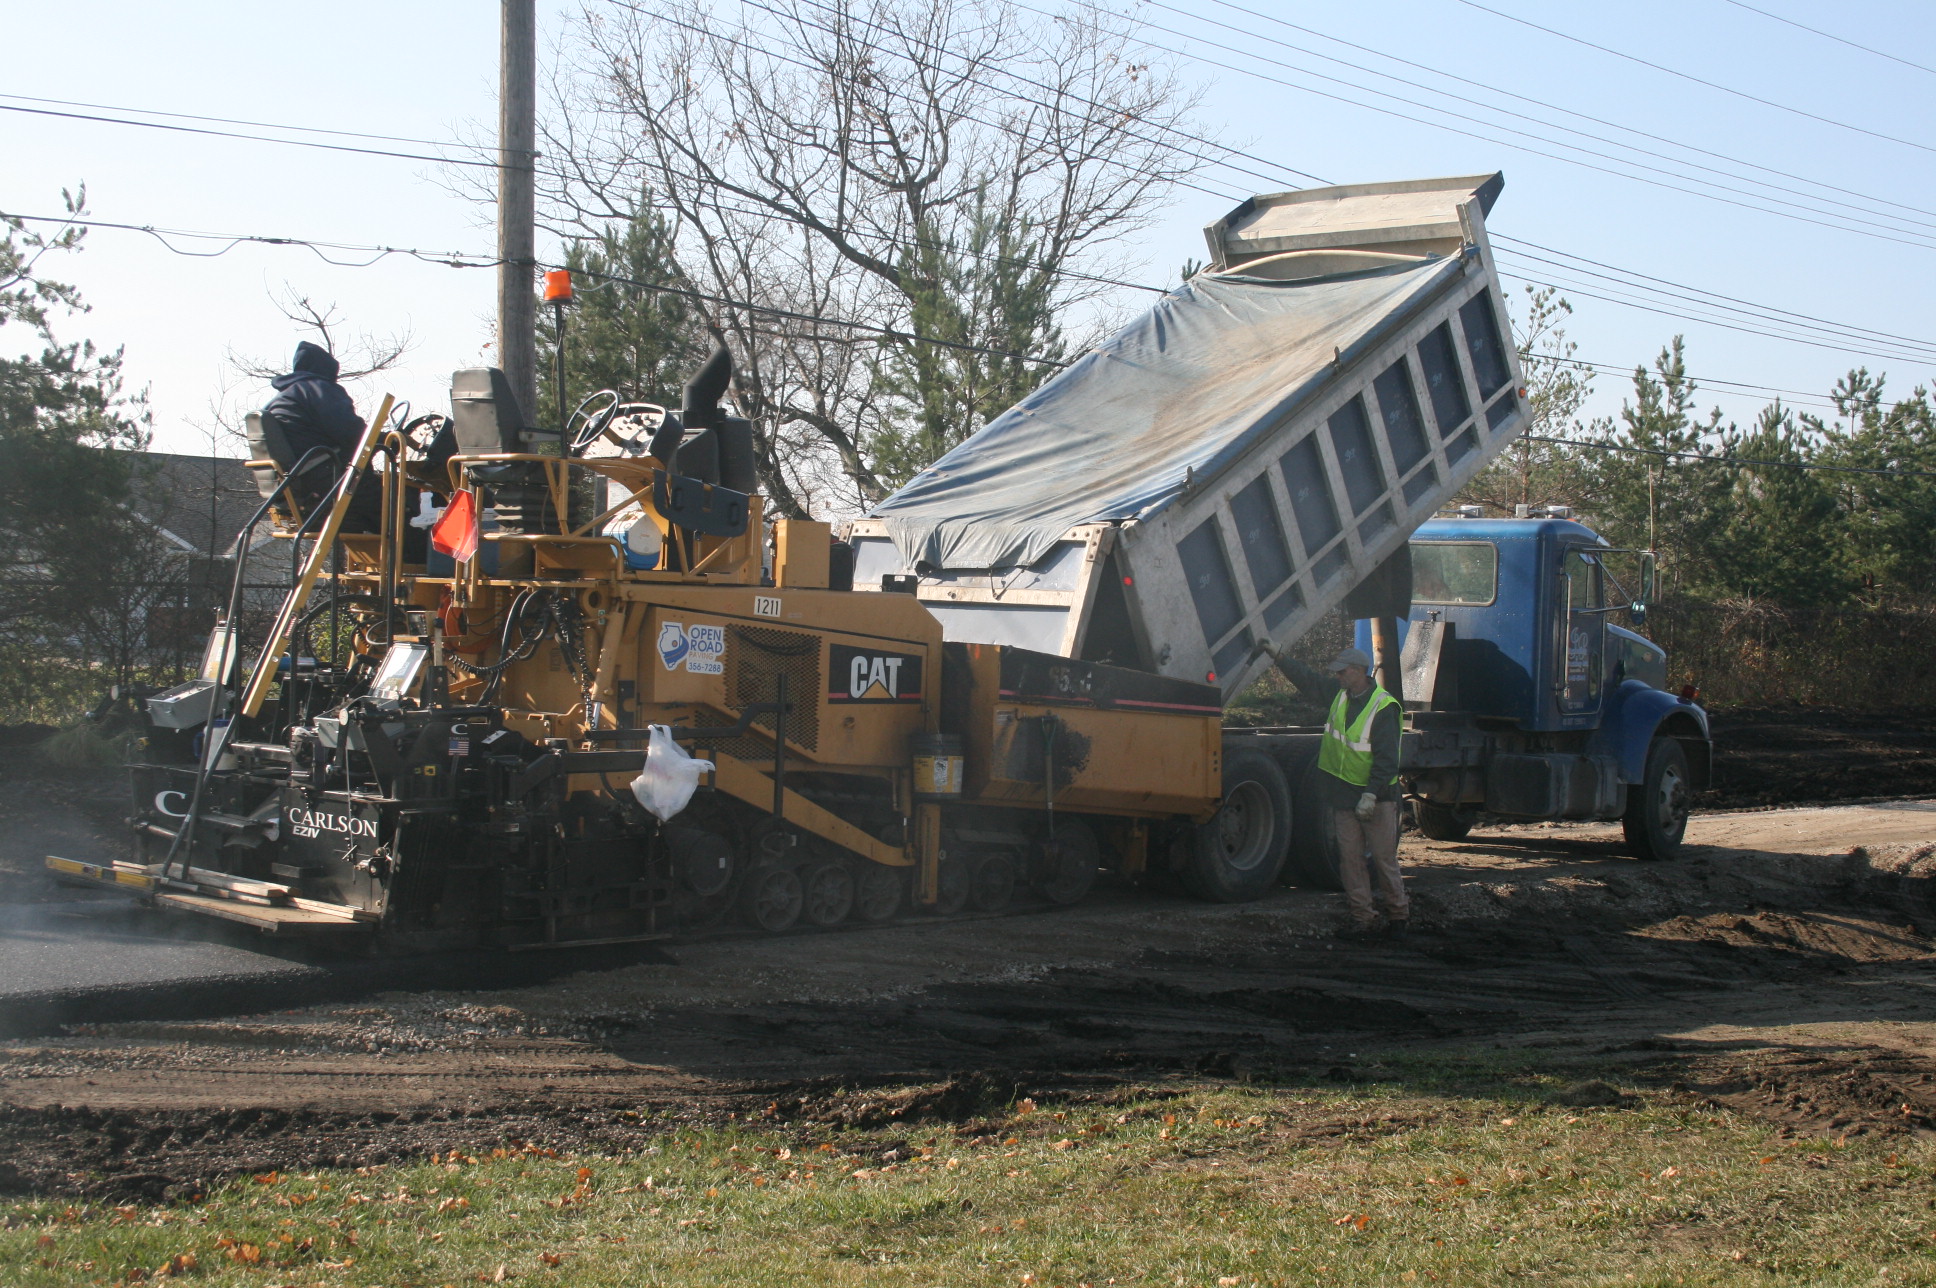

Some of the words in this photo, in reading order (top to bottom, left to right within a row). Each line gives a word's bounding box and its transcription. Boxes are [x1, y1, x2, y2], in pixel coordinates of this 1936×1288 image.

[757, 598, 779, 616] 1211
[690, 627, 722, 641] OPEN
[690, 640, 723, 653] ROAD
[688, 651, 714, 660] PAVING
[688, 662, 721, 673] 356-7288
[850, 655, 902, 699] CAT
[155, 790, 190, 818] C
[289, 807, 378, 838] CARLSON
